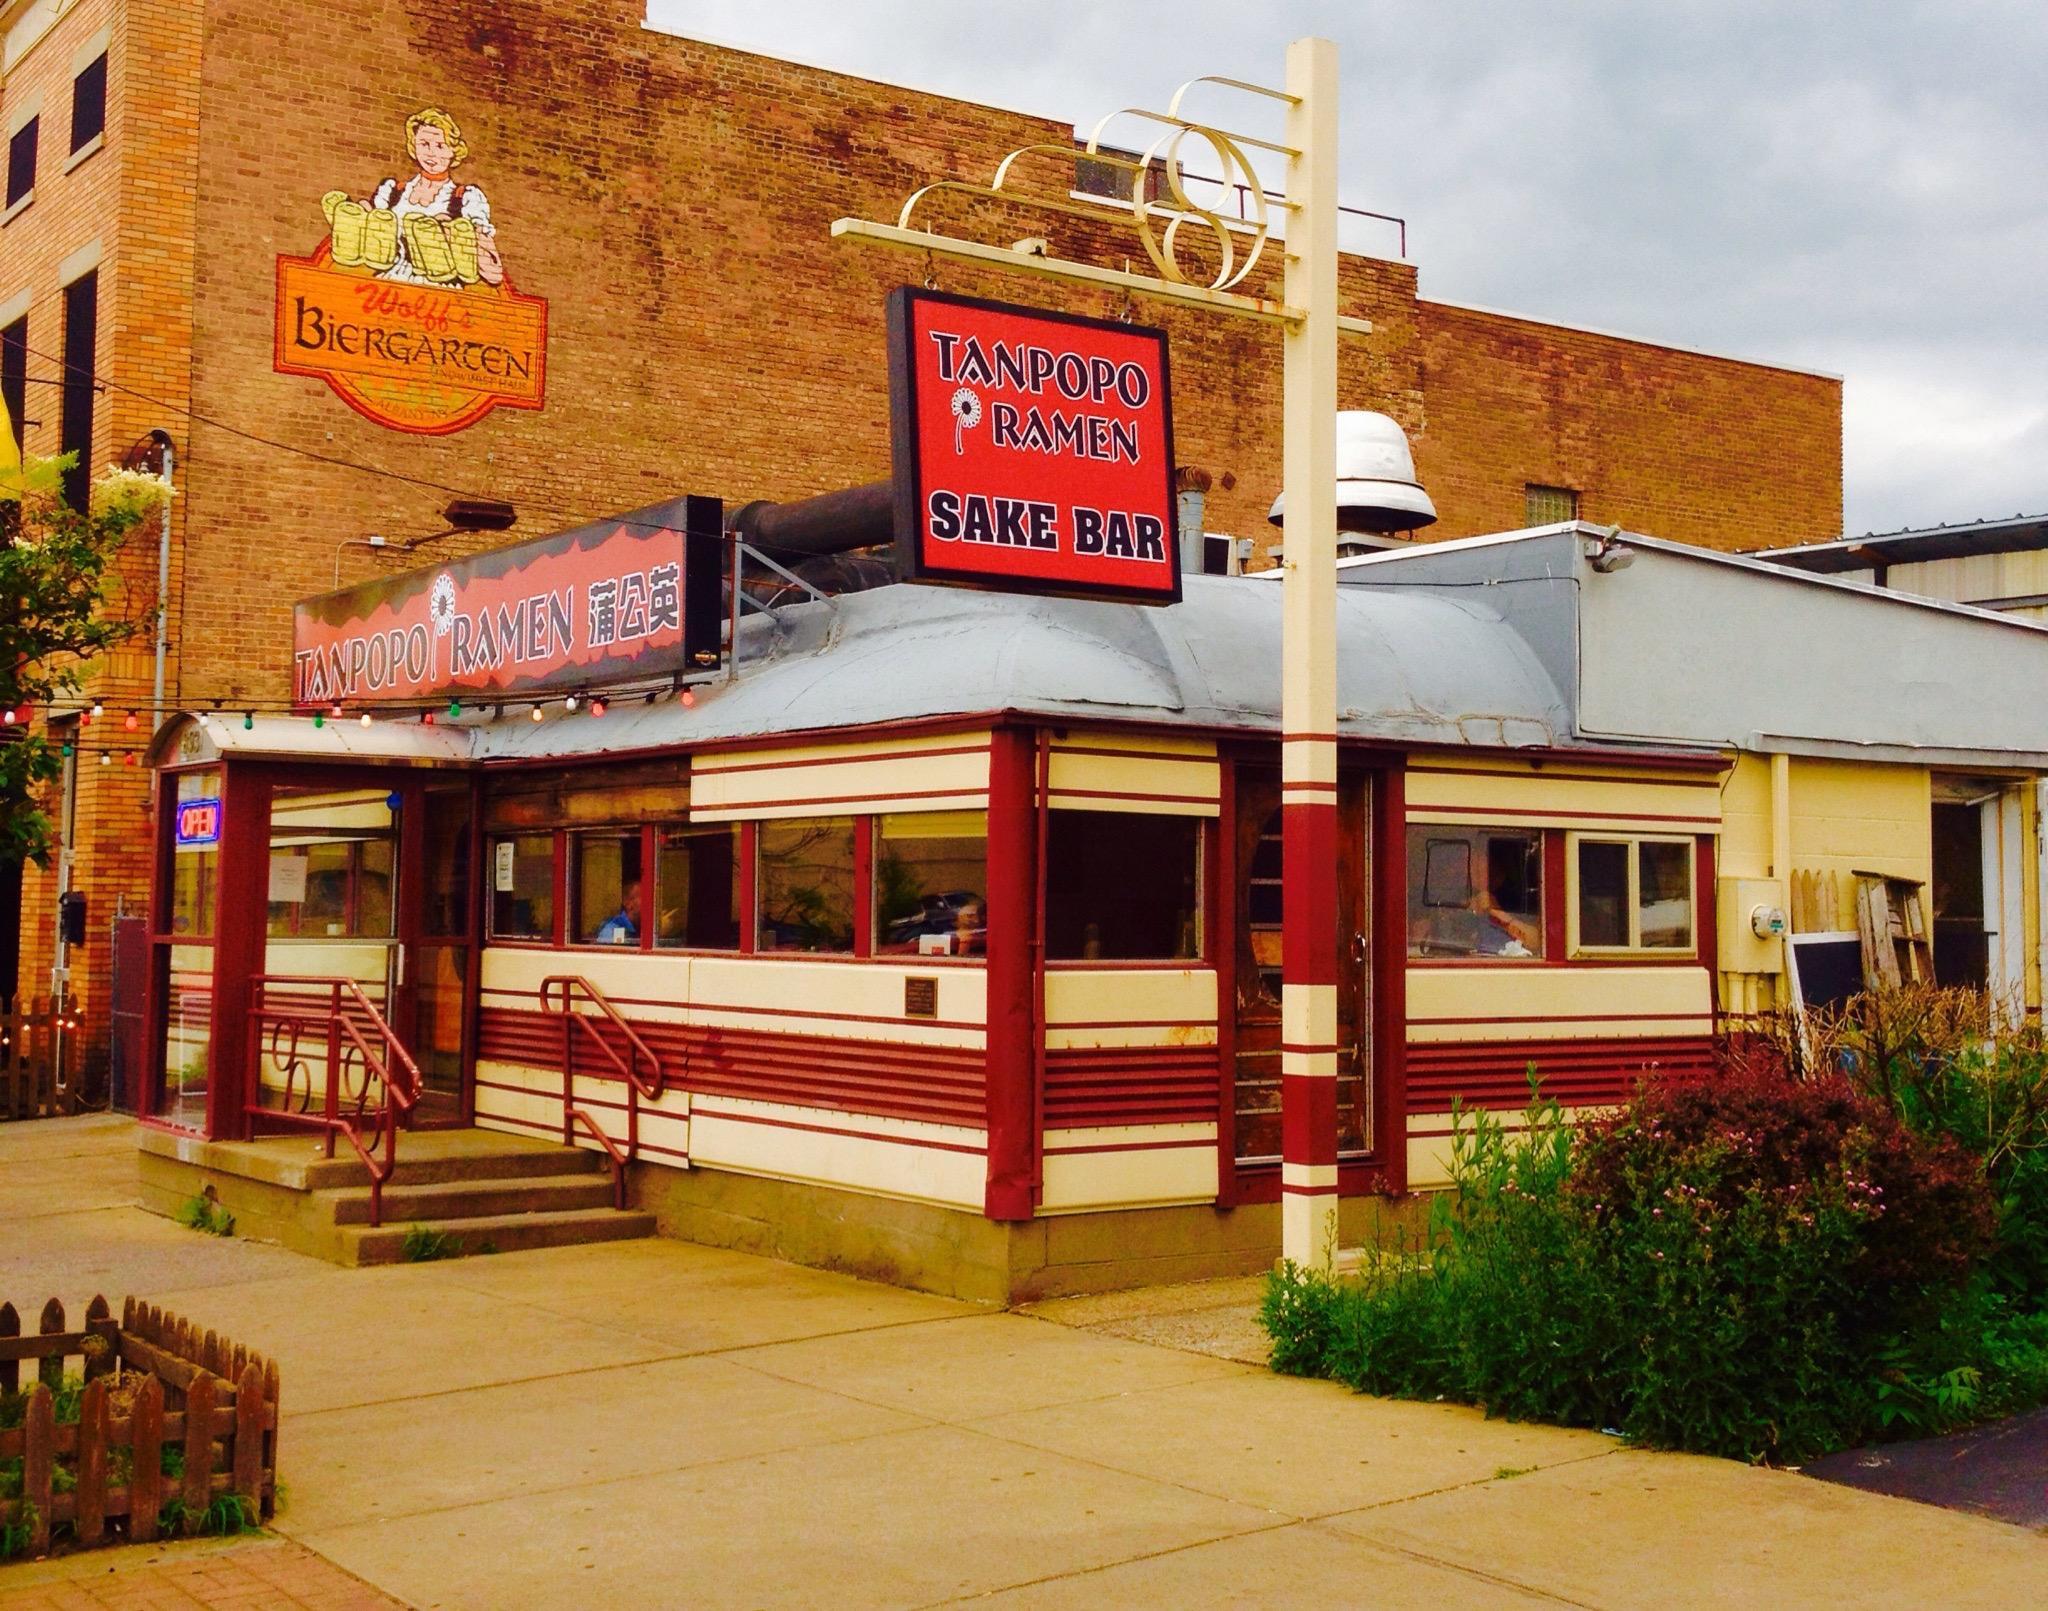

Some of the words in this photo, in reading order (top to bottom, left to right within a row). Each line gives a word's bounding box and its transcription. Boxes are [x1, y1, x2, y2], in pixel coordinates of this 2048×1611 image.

[929, 330, 1150, 409] TANPOPO
[991, 403, 1141, 465] RAMEN
[929, 489, 1059, 552] SAKE
[1072, 506, 1166, 563] BAR
[296, 622, 429, 702] TANPOPO
[450, 585, 575, 676] RAMEN
[587, 562, 680, 649] 蒲公英
[181, 806, 217, 838] OPEN
